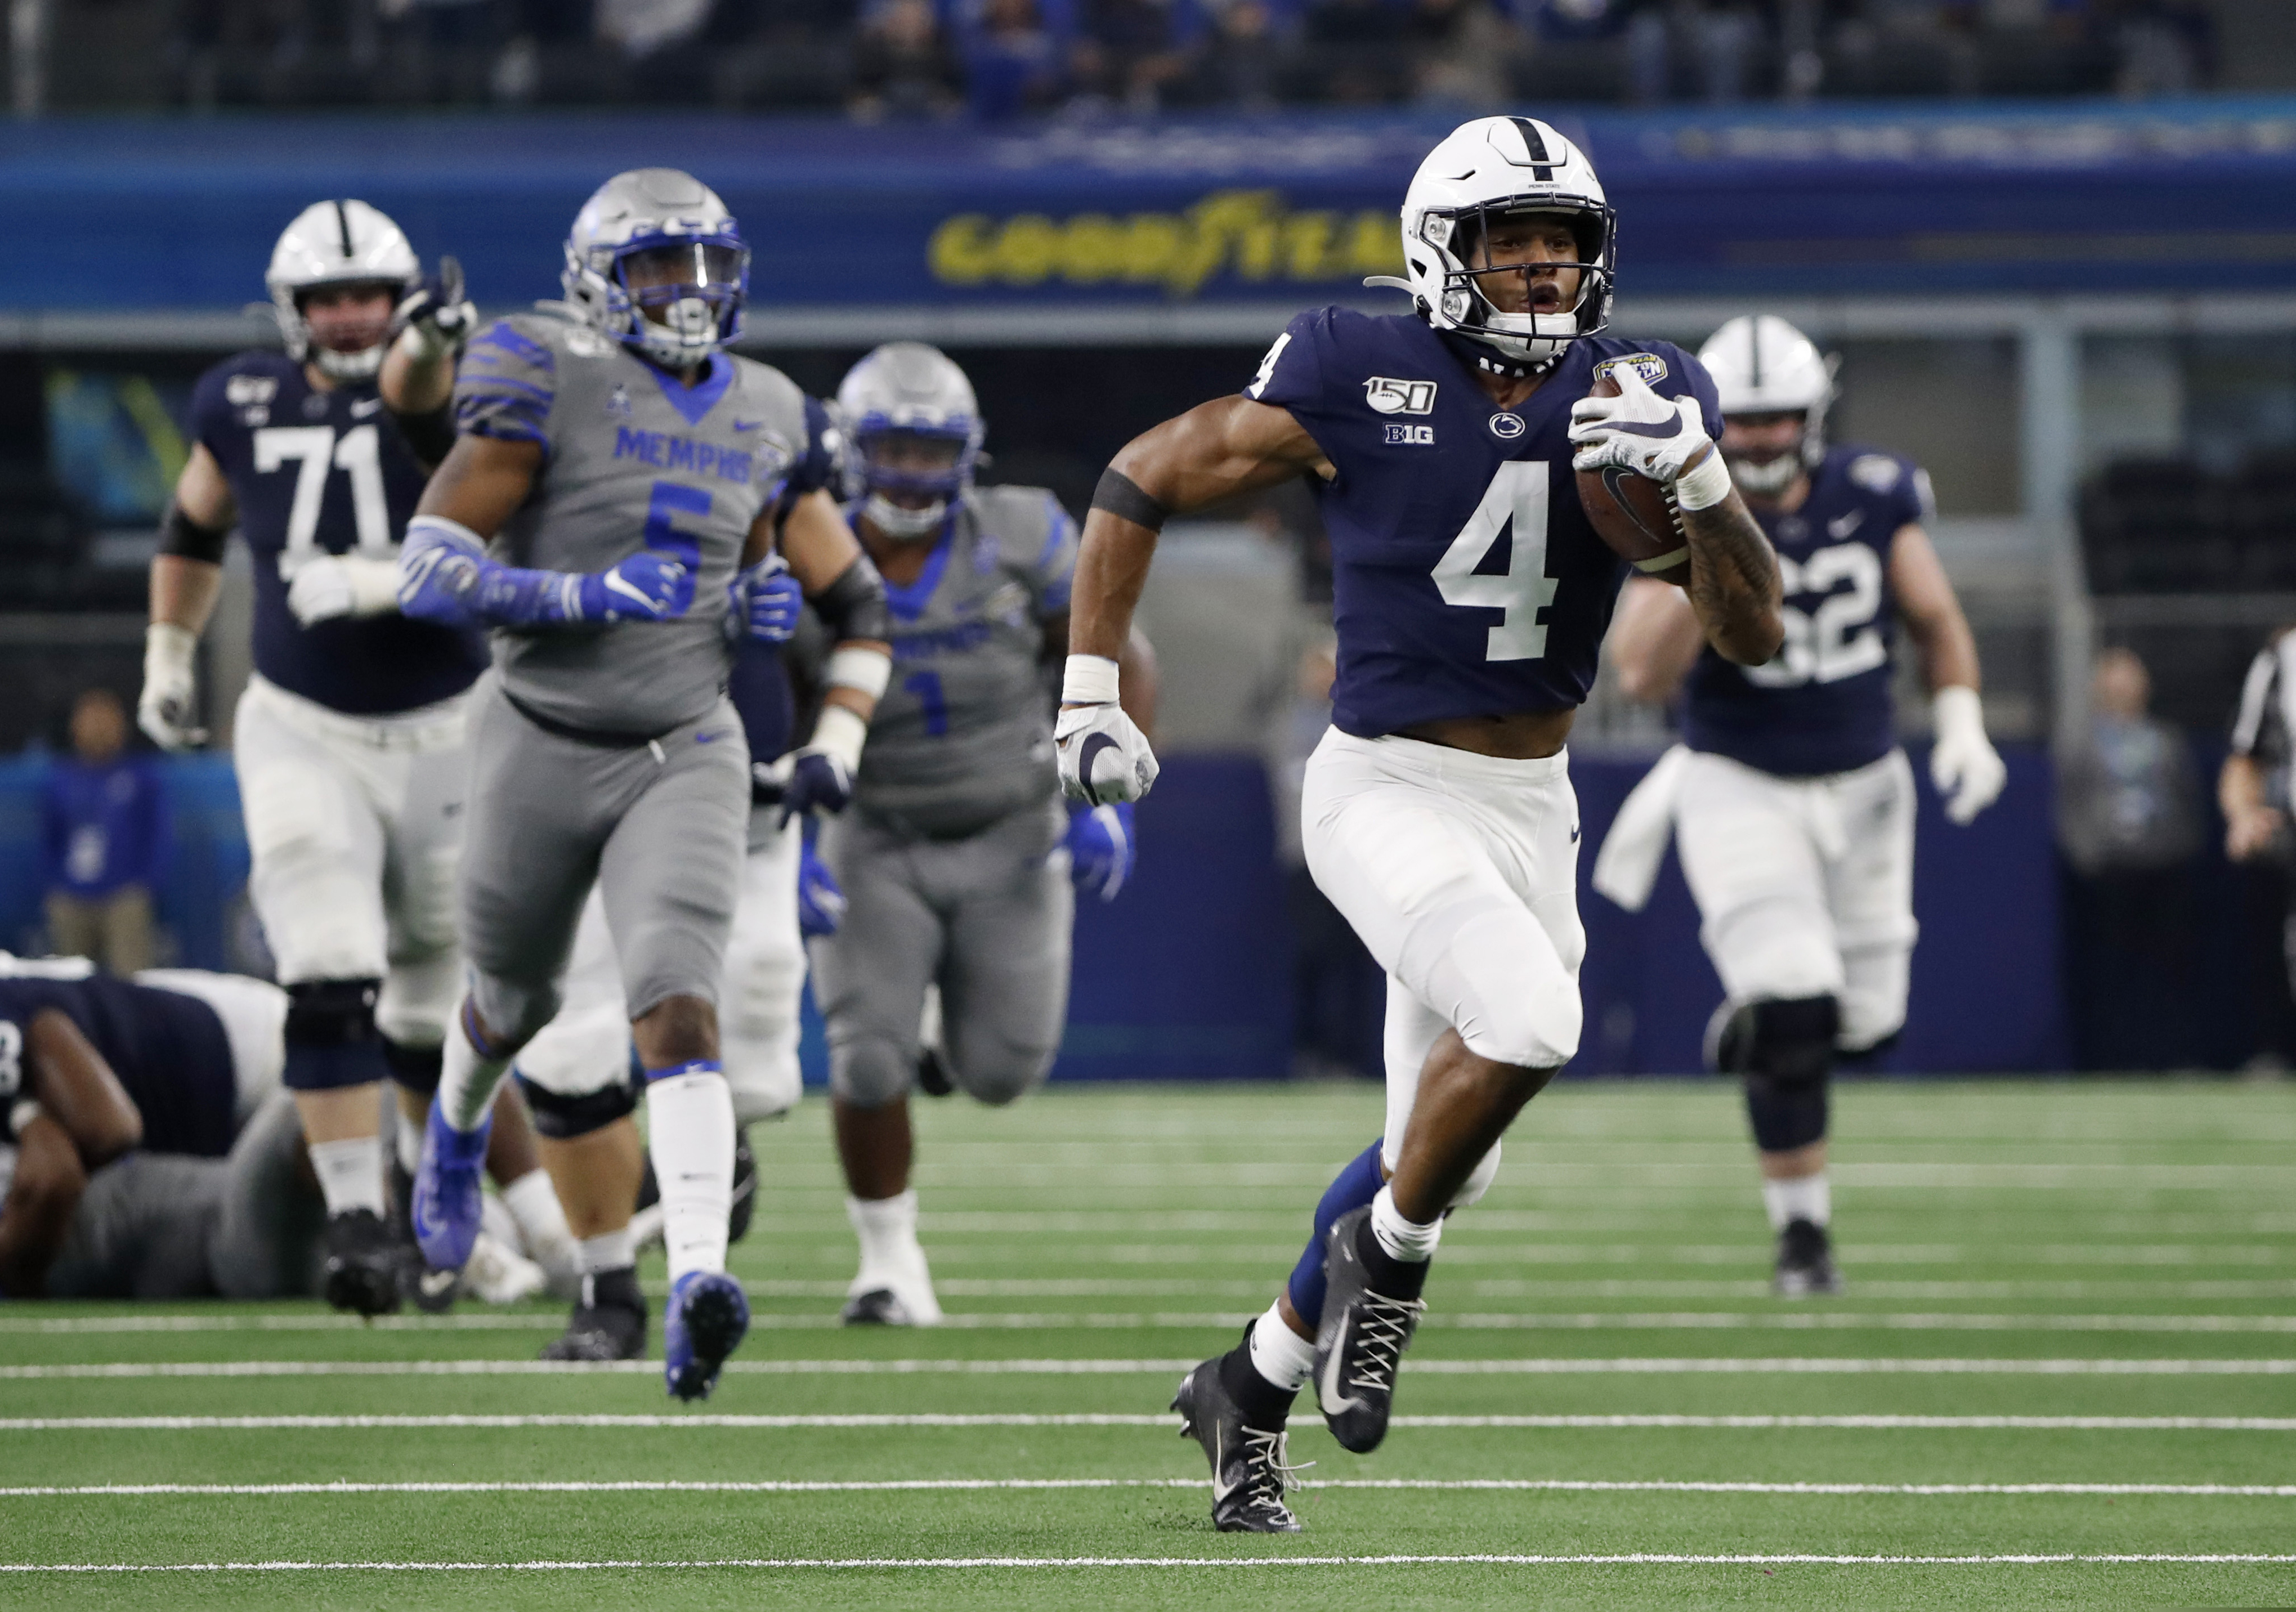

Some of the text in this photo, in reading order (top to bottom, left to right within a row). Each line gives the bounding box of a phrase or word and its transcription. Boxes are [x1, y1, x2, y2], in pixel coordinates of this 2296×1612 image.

[1363, 377, 1436, 414] 150
[253, 426, 402, 580] 71
[1430, 460, 1559, 661] 4
[903, 671, 948, 737] 1
